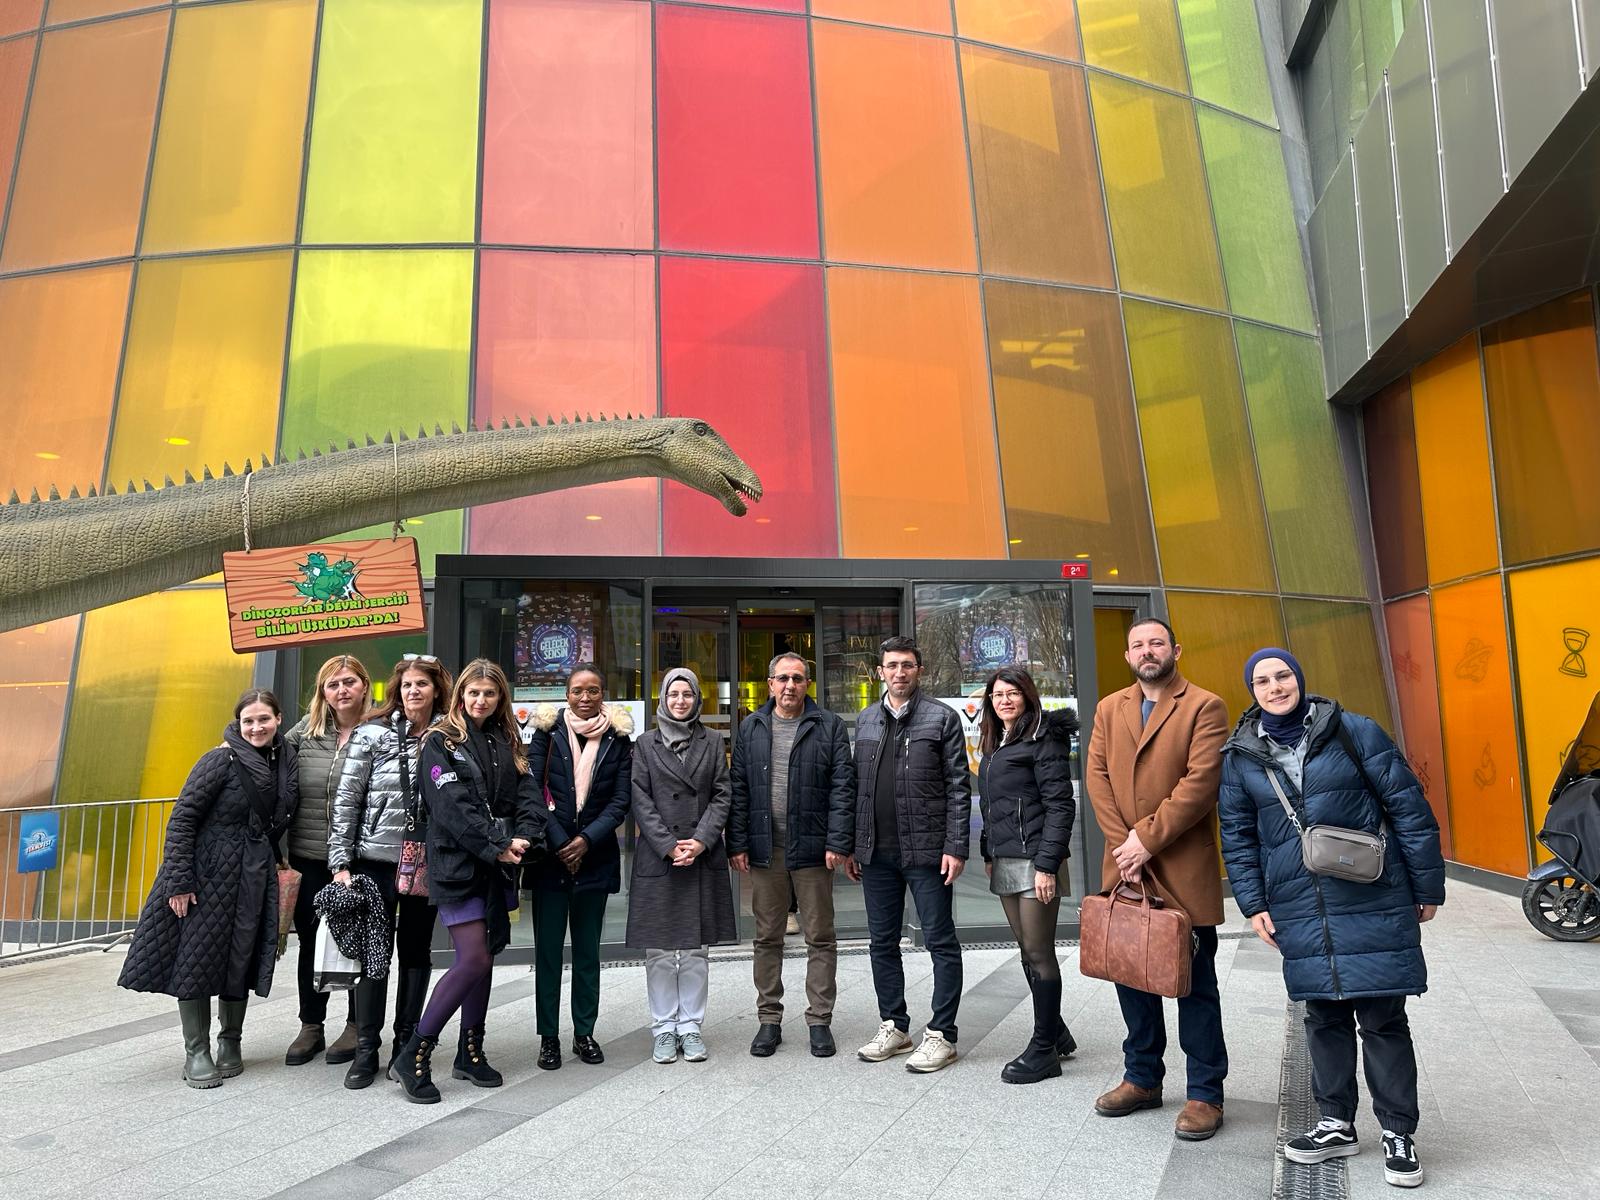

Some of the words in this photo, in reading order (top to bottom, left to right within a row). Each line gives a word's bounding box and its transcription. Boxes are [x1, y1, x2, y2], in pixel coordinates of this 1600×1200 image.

[242, 605, 325, 620] DİNOZORLAR
[326, 597, 363, 612] DEVRİ
[364, 592, 408, 606] SERGİSİ
[256, 619, 298, 637] BİLİM
[301, 612, 399, 632] ÜSKÜDAR'DA!
[540, 637, 569, 651] GELECEK
[980, 637, 1006, 650] GELECEK
